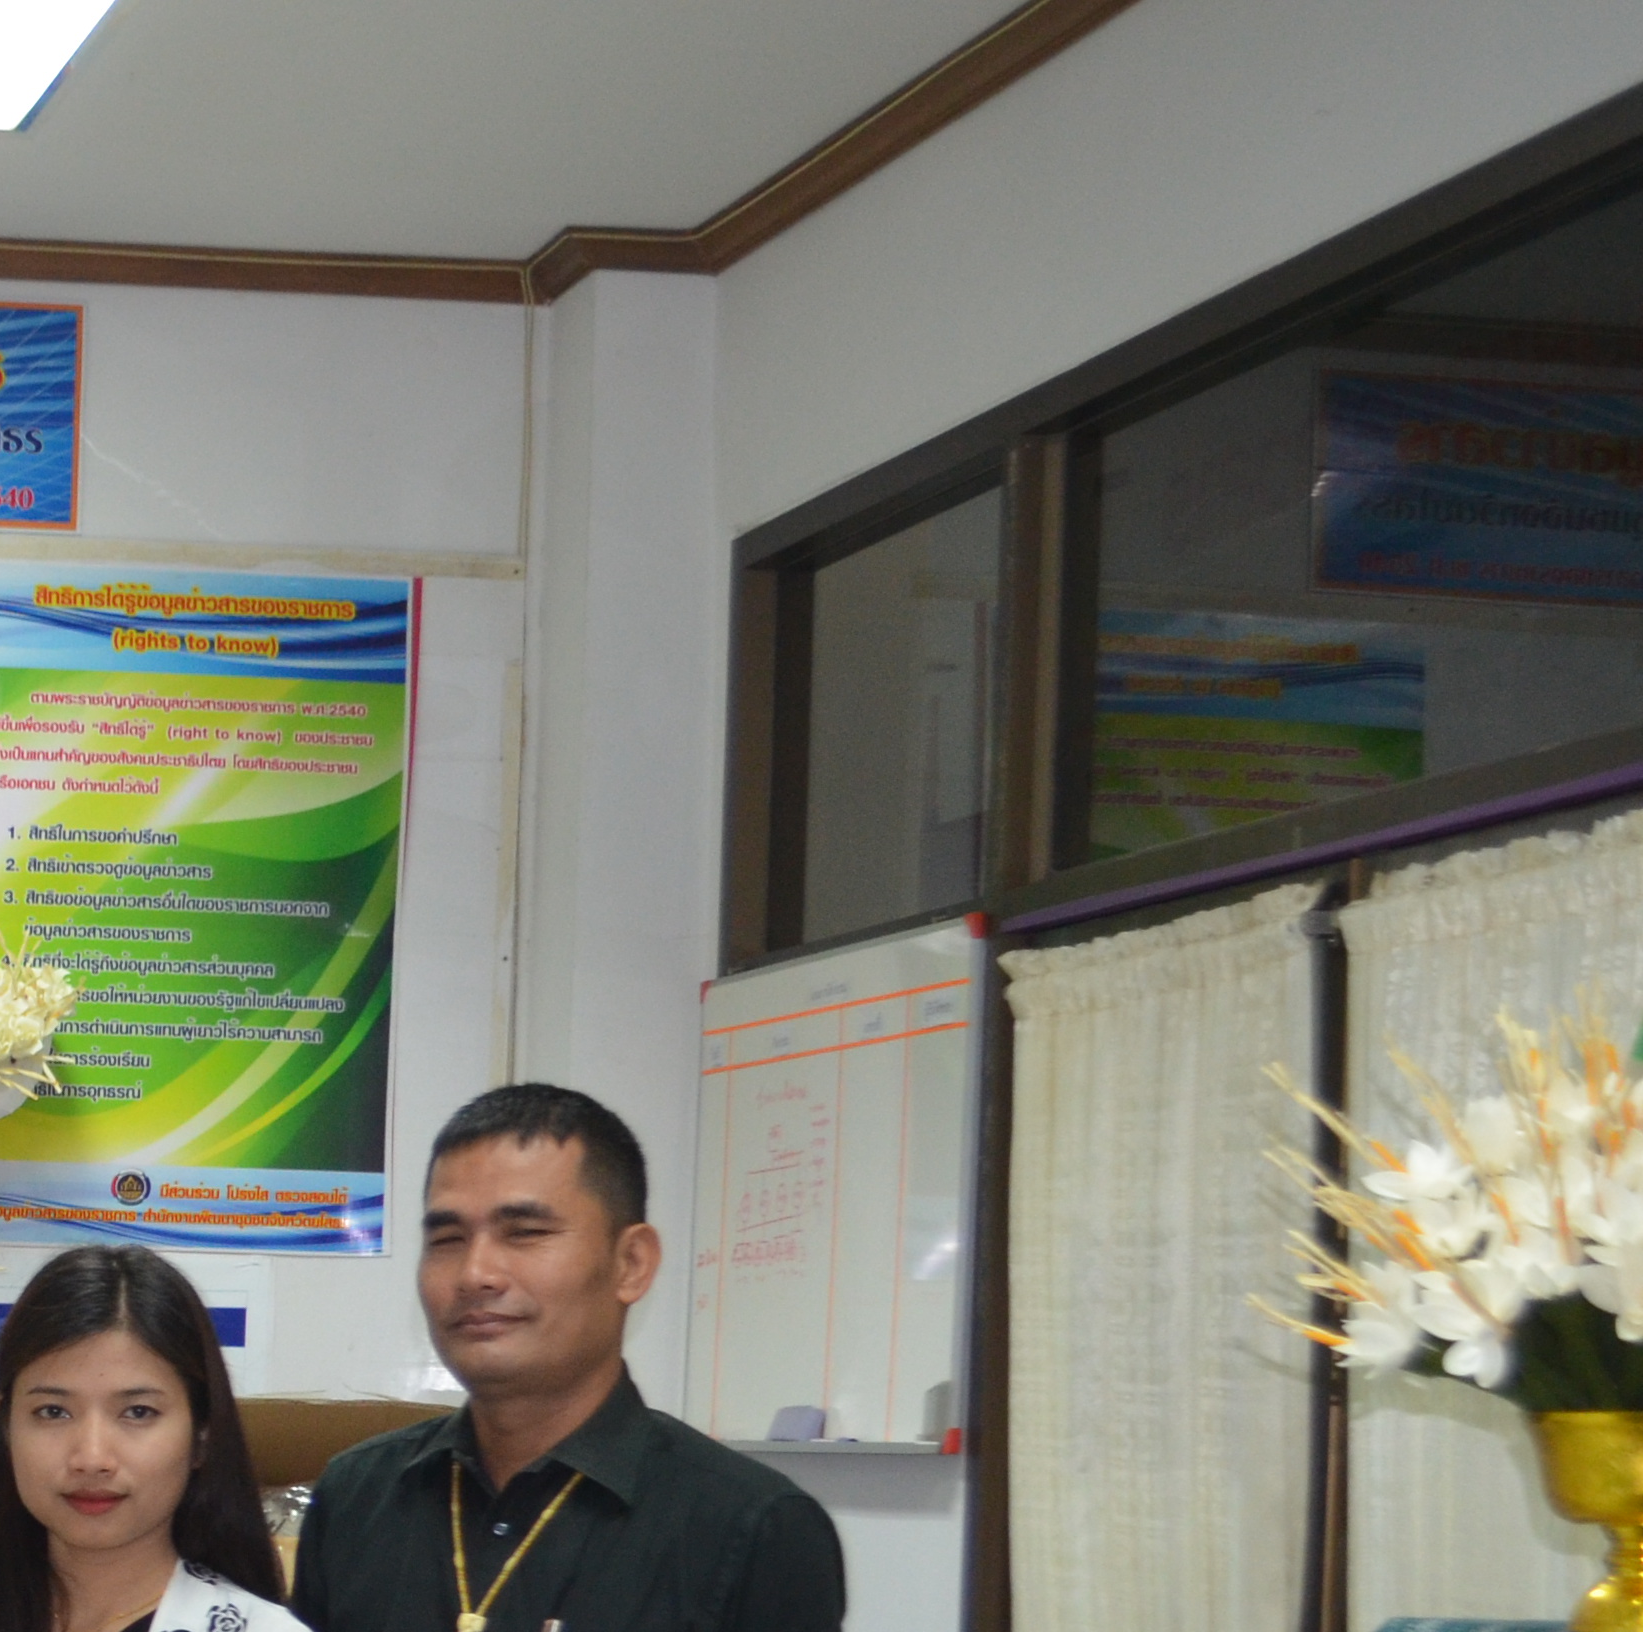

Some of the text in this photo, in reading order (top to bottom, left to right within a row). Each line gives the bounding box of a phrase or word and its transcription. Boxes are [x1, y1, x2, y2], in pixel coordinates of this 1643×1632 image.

[112, 626, 279, 659] (rights to know)
[167, 725, 208, 742] (right
[215, 728, 230, 741] to
[236, 728, 283, 746] know)
[7, 826, 21, 841] 1.
[5, 857, 20, 873] 2.
[3, 890, 18, 905] 3.
